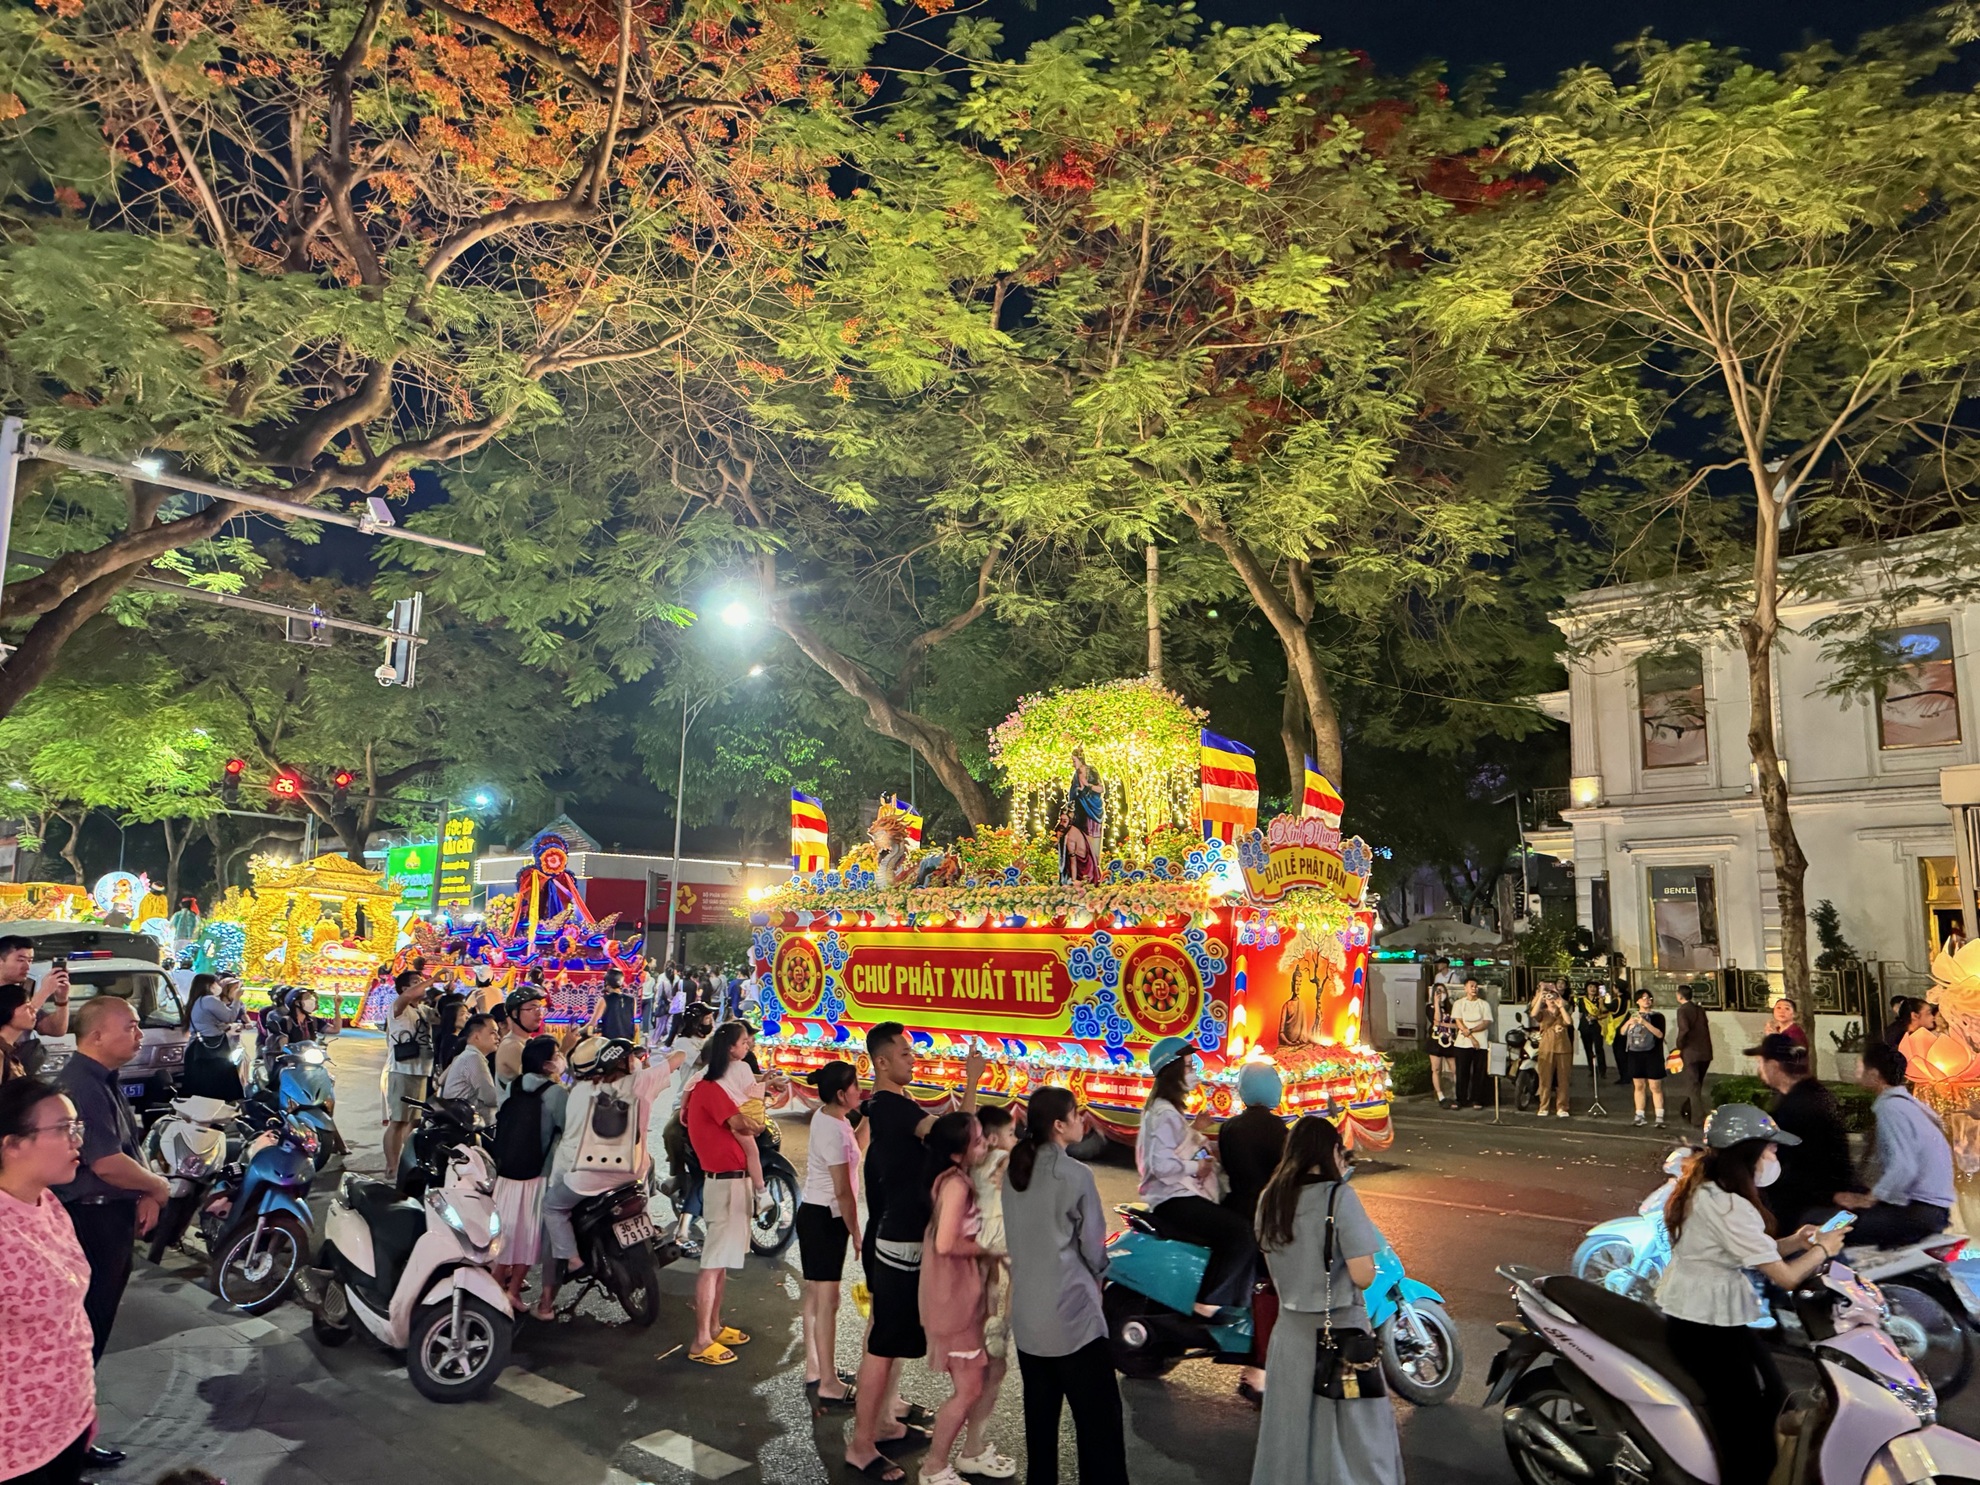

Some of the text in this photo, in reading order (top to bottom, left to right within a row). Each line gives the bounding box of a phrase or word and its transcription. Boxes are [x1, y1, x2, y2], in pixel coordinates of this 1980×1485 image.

[276, 778, 294, 793] 26
[1265, 852, 1347, 889] ĐẠI LỄ PHẬT ĐẢN
[1663, 886, 1697, 895] BENTLE
[852, 958, 1054, 1003] CHƯ PHẬT XUẤT THẾ
[623, 1226, 651, 1245] 7913
